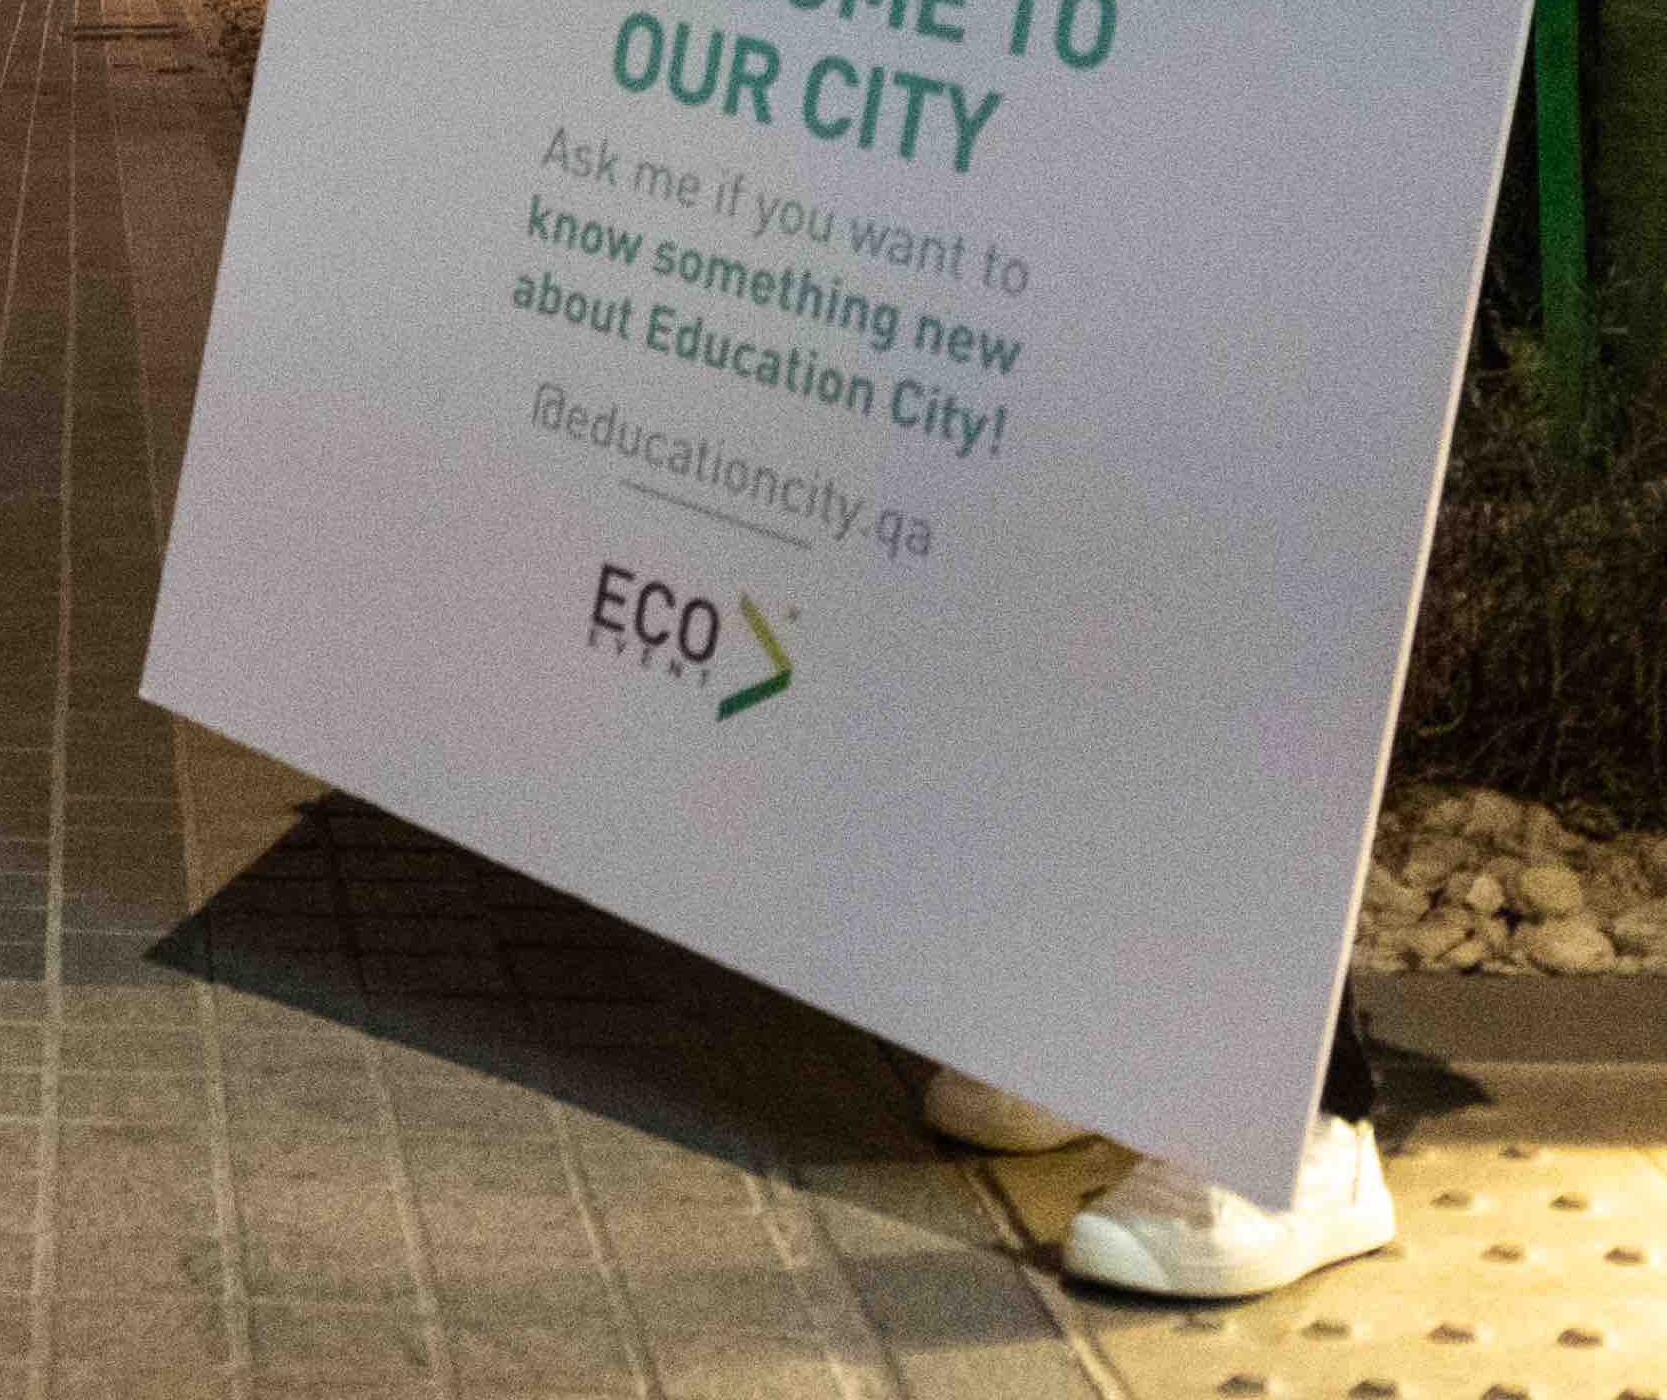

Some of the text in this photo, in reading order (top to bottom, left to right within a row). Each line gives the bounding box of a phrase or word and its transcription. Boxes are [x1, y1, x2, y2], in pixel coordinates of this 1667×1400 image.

[613, 12, 1005, 174] OUR CITY
[527, 195, 1022, 376] know something new
[540, 127, 1030, 297] Ask me if you want to
[511, 271, 1008, 459] about Education City!
[531, 381, 933, 559] @educationcity.qa
[593, 563, 721, 664] ECO
